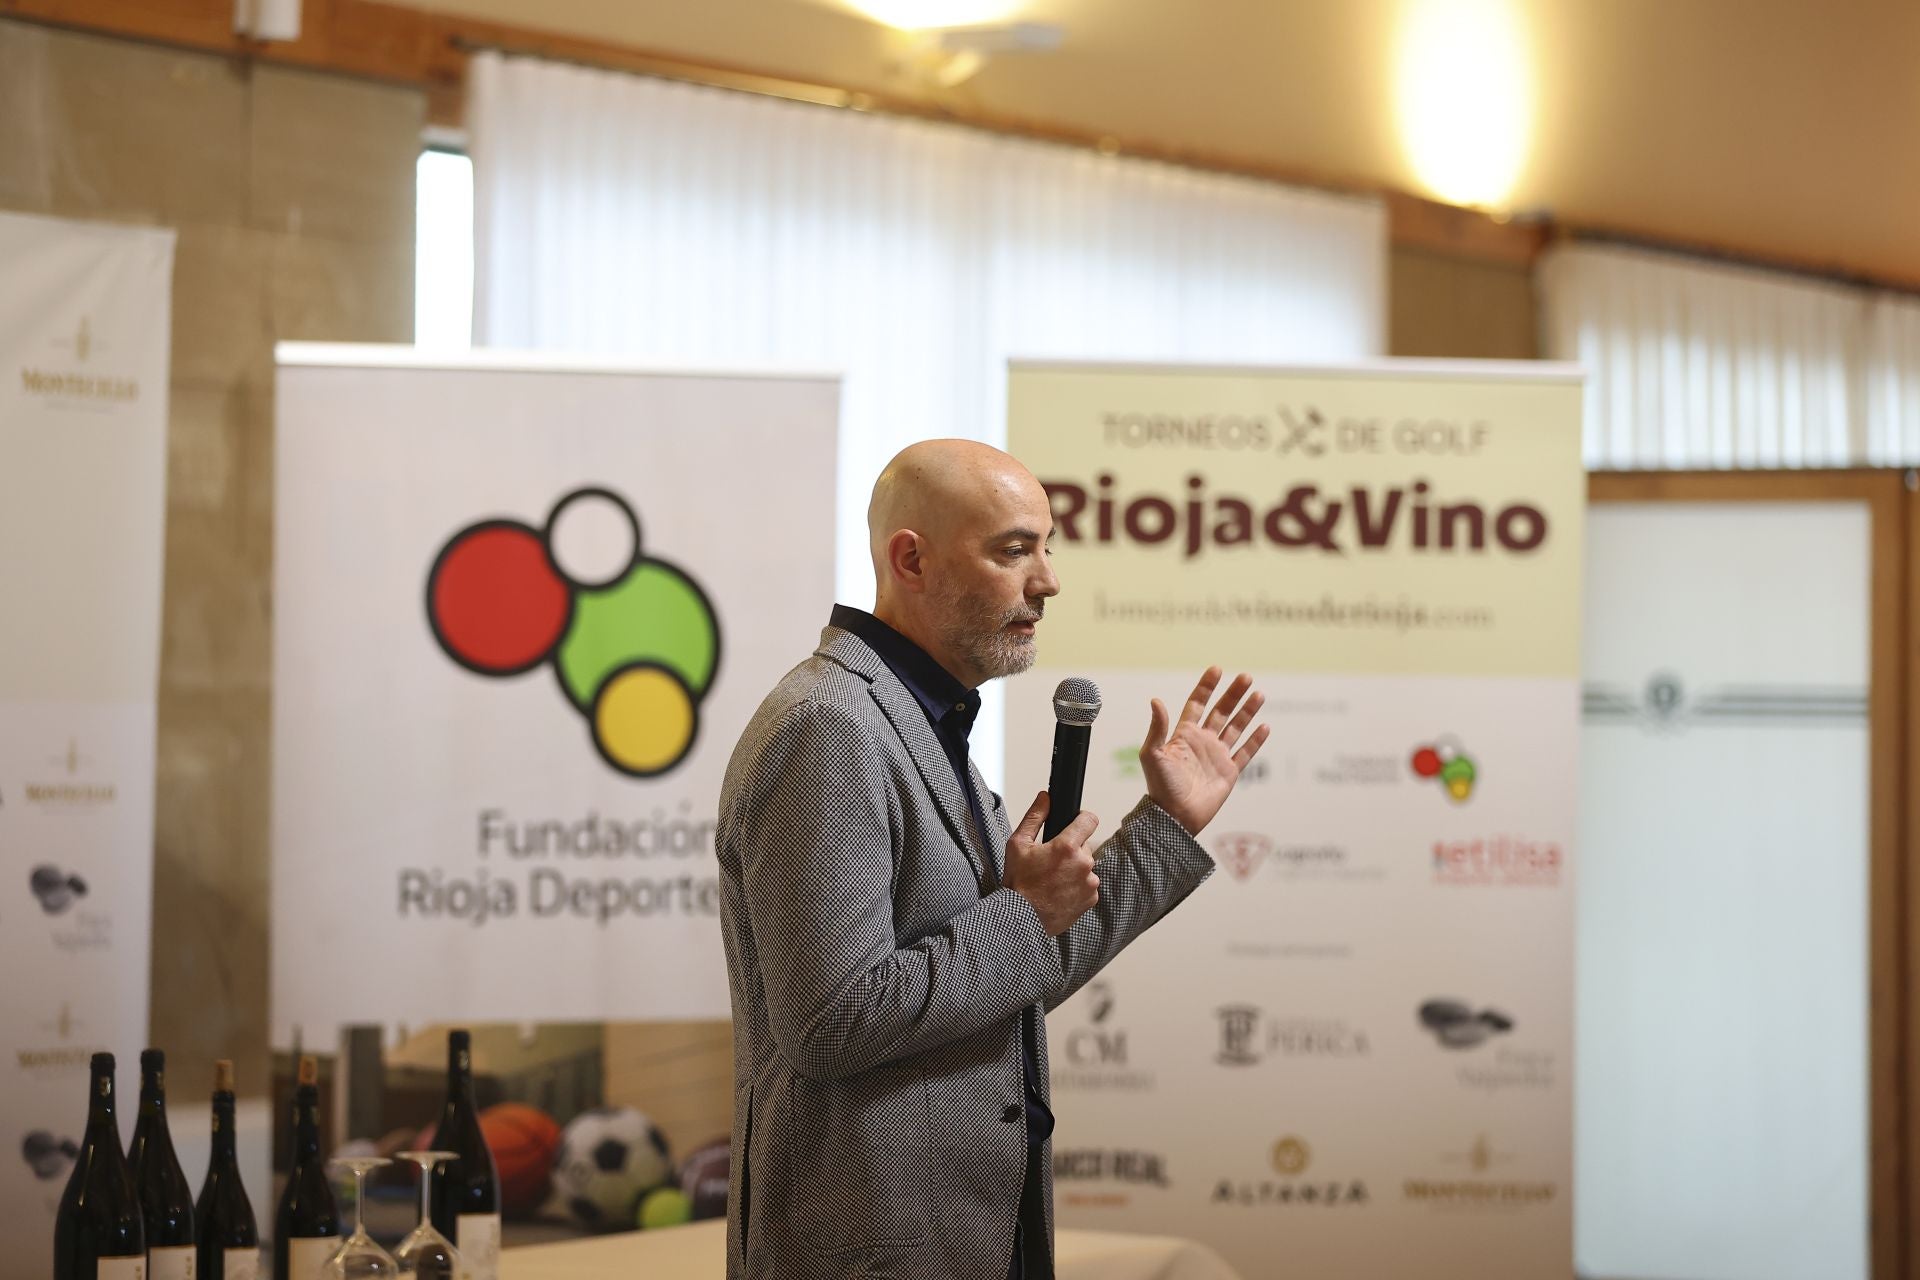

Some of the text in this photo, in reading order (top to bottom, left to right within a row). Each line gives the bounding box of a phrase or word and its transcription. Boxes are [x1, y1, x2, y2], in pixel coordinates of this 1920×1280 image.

[1102, 413, 1490, 456] TORNEOS DE GOLF
[1041, 470, 1550, 562] Rioja&Vino
[477, 799, 719, 858] Fundación
[397, 866, 721, 928] Rioja Deporte
